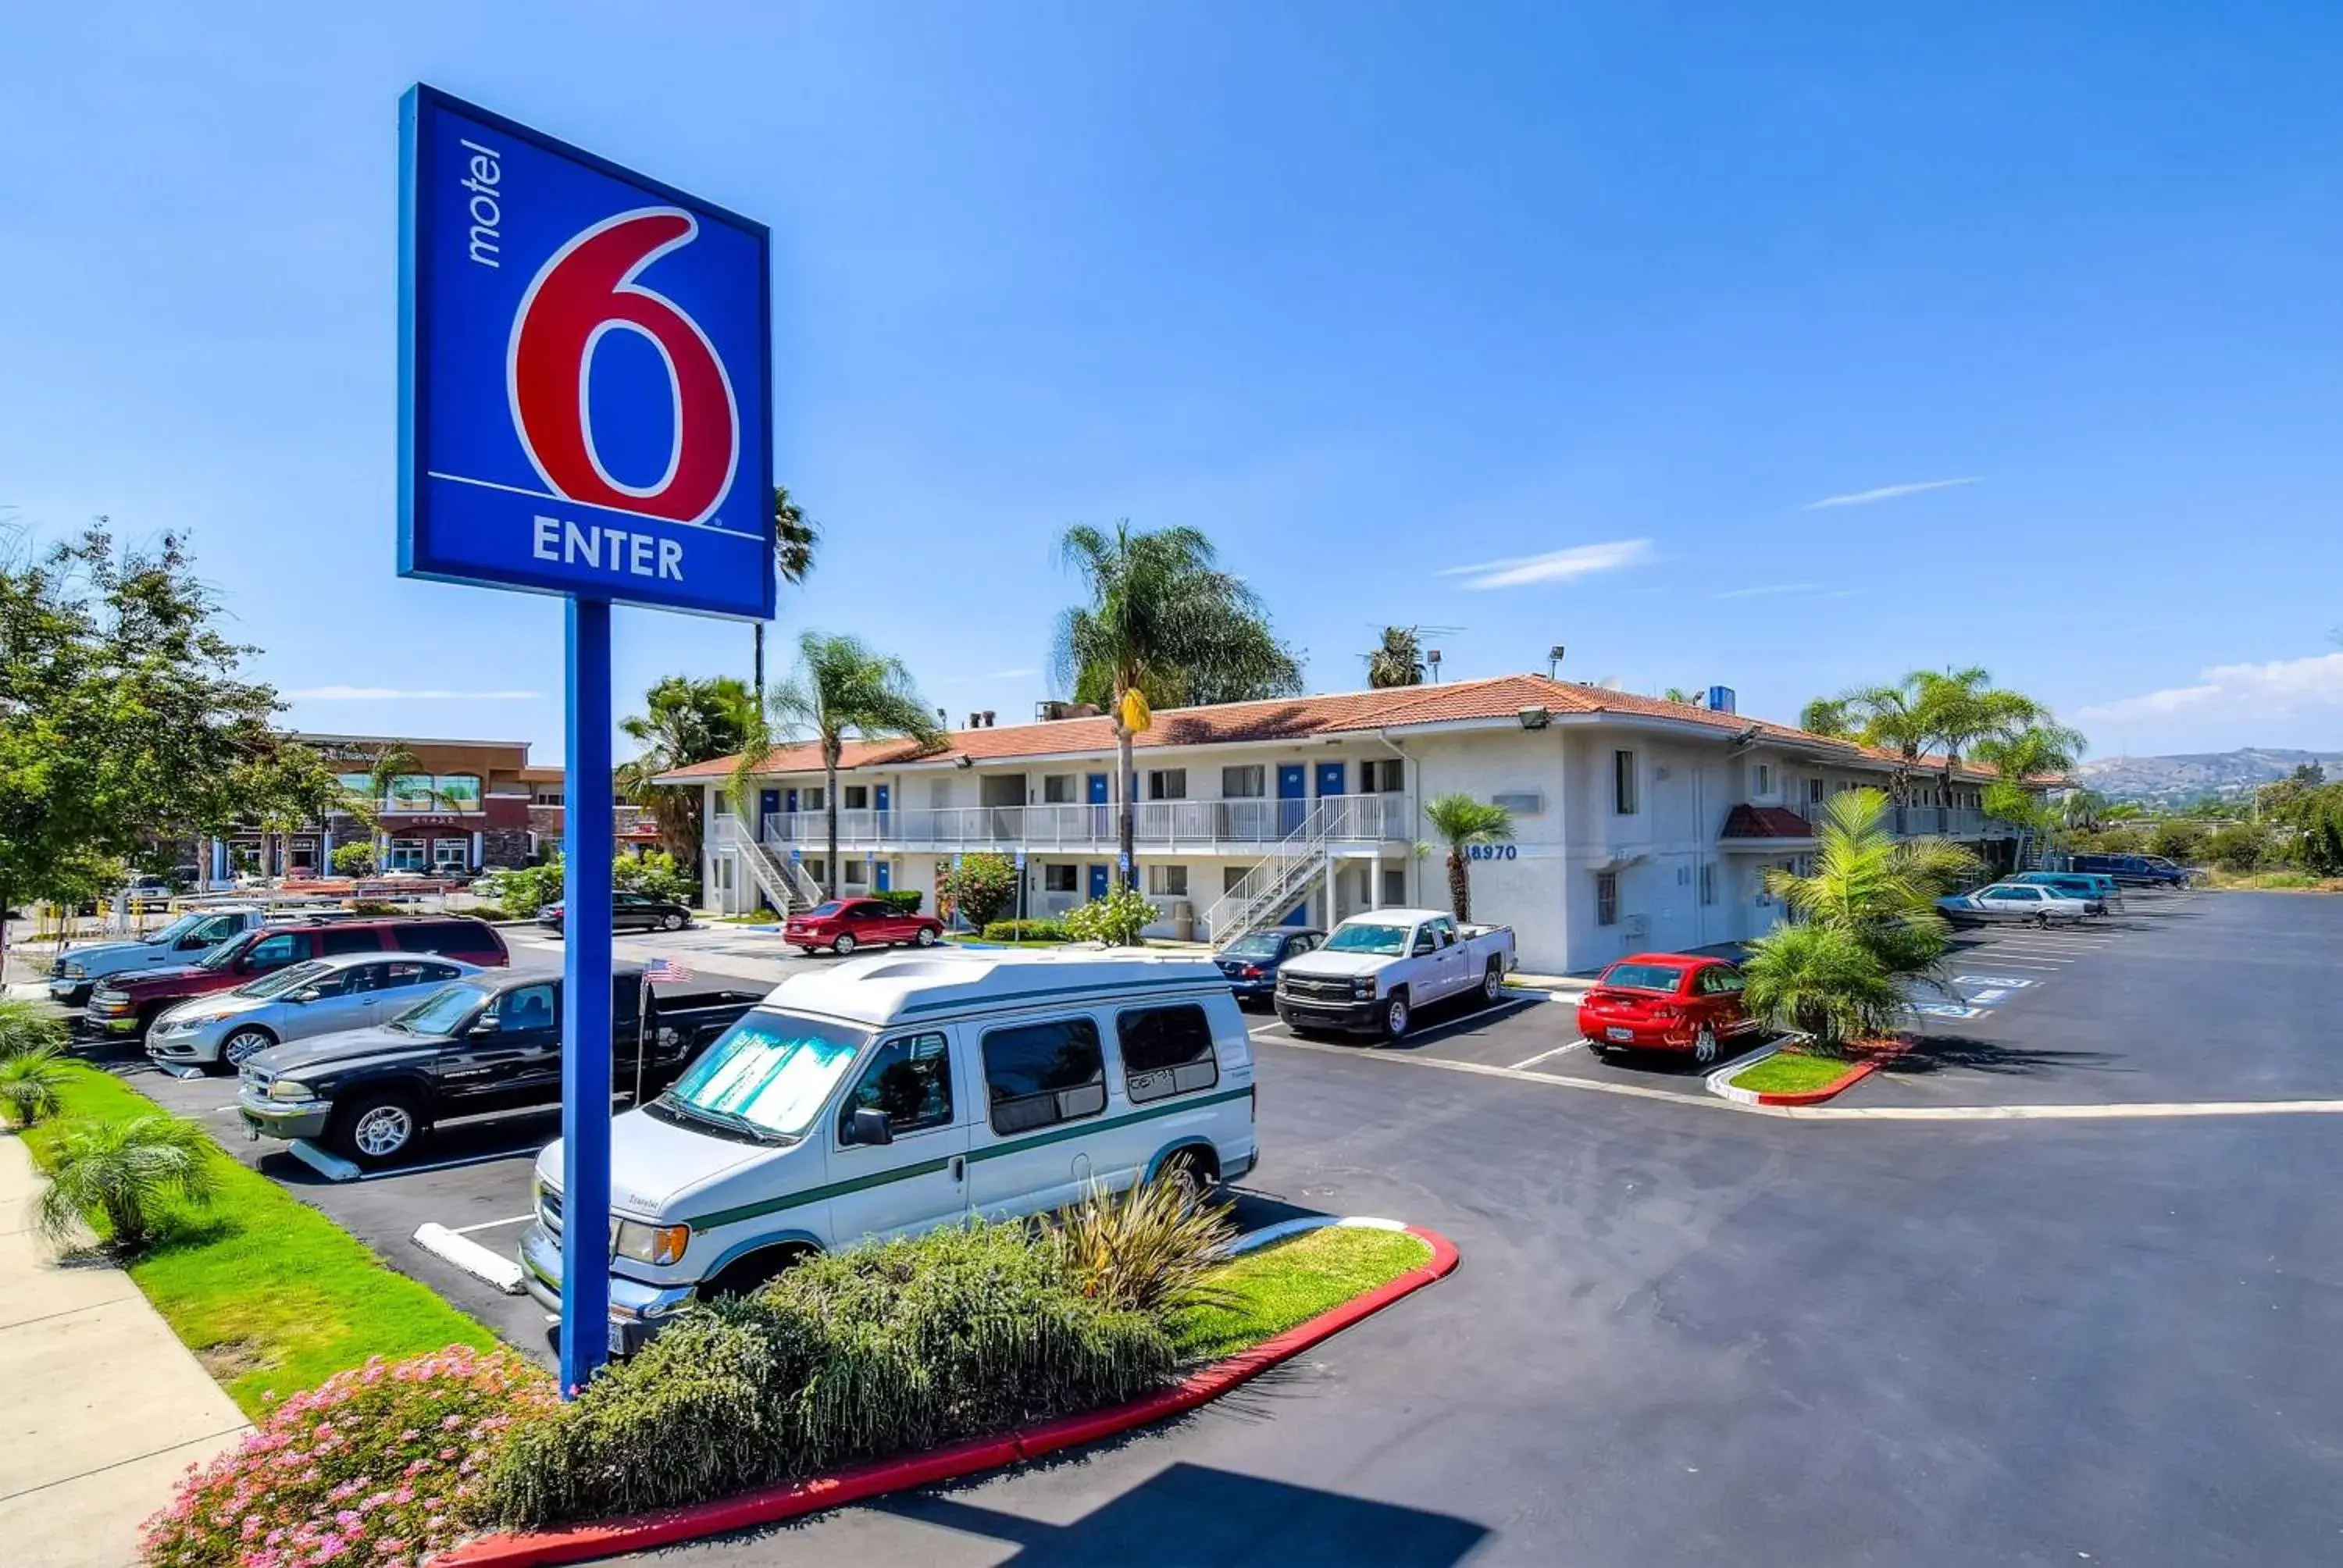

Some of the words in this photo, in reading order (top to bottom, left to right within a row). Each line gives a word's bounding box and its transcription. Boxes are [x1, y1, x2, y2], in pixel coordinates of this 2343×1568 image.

[461, 139, 500, 268] motel
[506, 205, 740, 525] 6
[533, 515, 683, 581] ENTER
